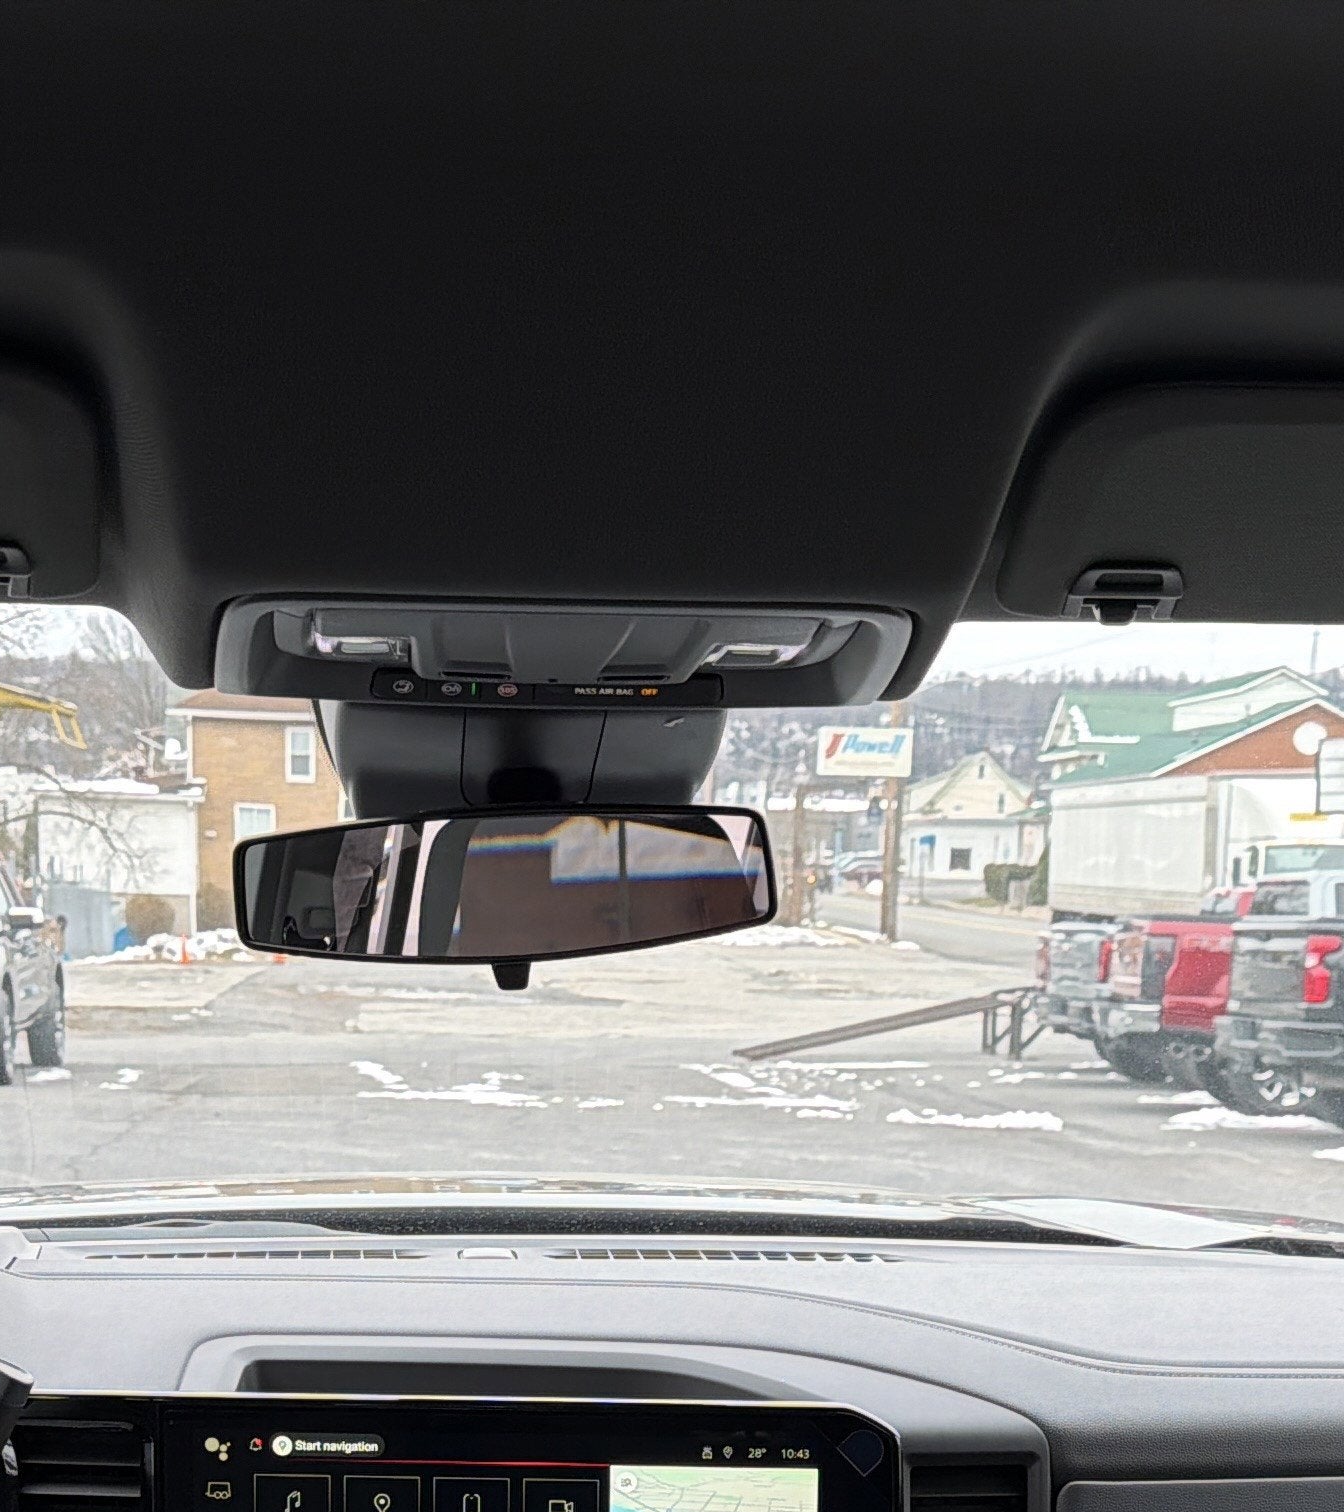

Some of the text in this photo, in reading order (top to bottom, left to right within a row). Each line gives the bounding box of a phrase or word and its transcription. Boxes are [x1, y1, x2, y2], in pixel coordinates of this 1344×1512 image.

[574, 687, 596, 695] PASS
[615, 688, 633, 696] BAG
[295, 1441, 379, 1455] Start navigation
[747, 1447, 767, 1459] 28°
[781, 1448, 810, 1459] 10:43
